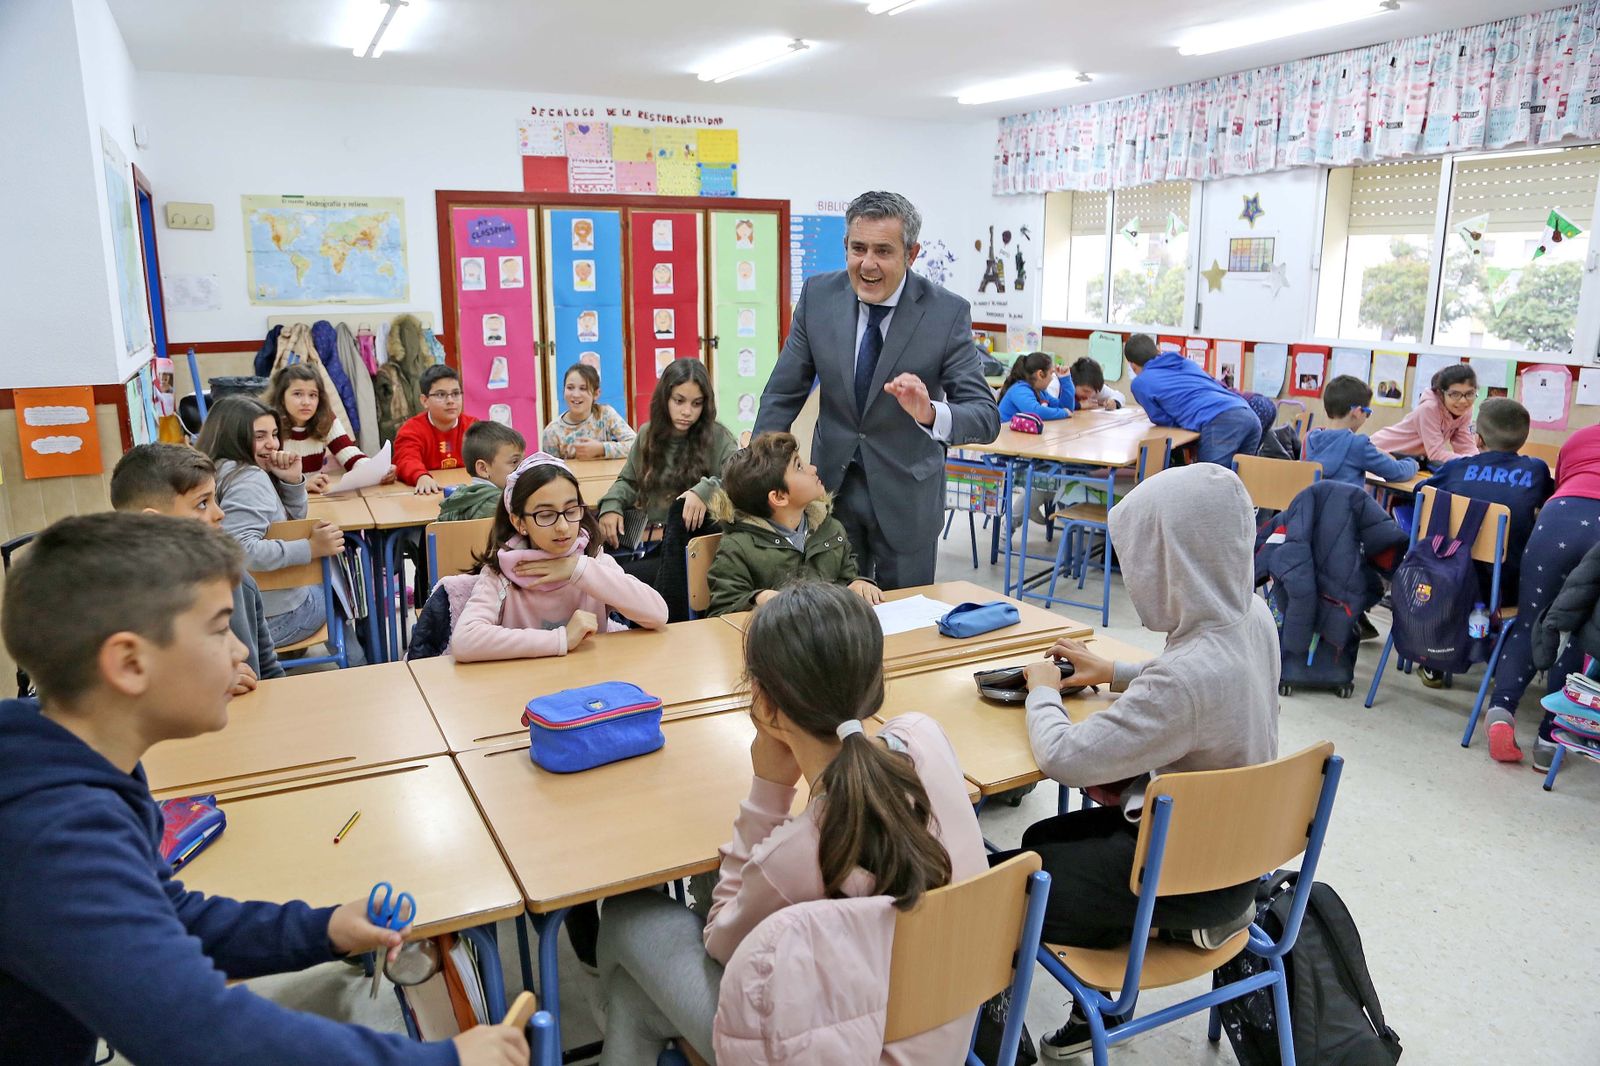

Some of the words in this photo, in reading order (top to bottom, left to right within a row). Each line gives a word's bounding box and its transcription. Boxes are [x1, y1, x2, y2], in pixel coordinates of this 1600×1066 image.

[606, 108, 617, 117] DE
[622, 108, 632, 117] LA
[638, 109, 724, 125] RESPONSABILIDAD
[1463, 464, 1532, 488] BARÇA
